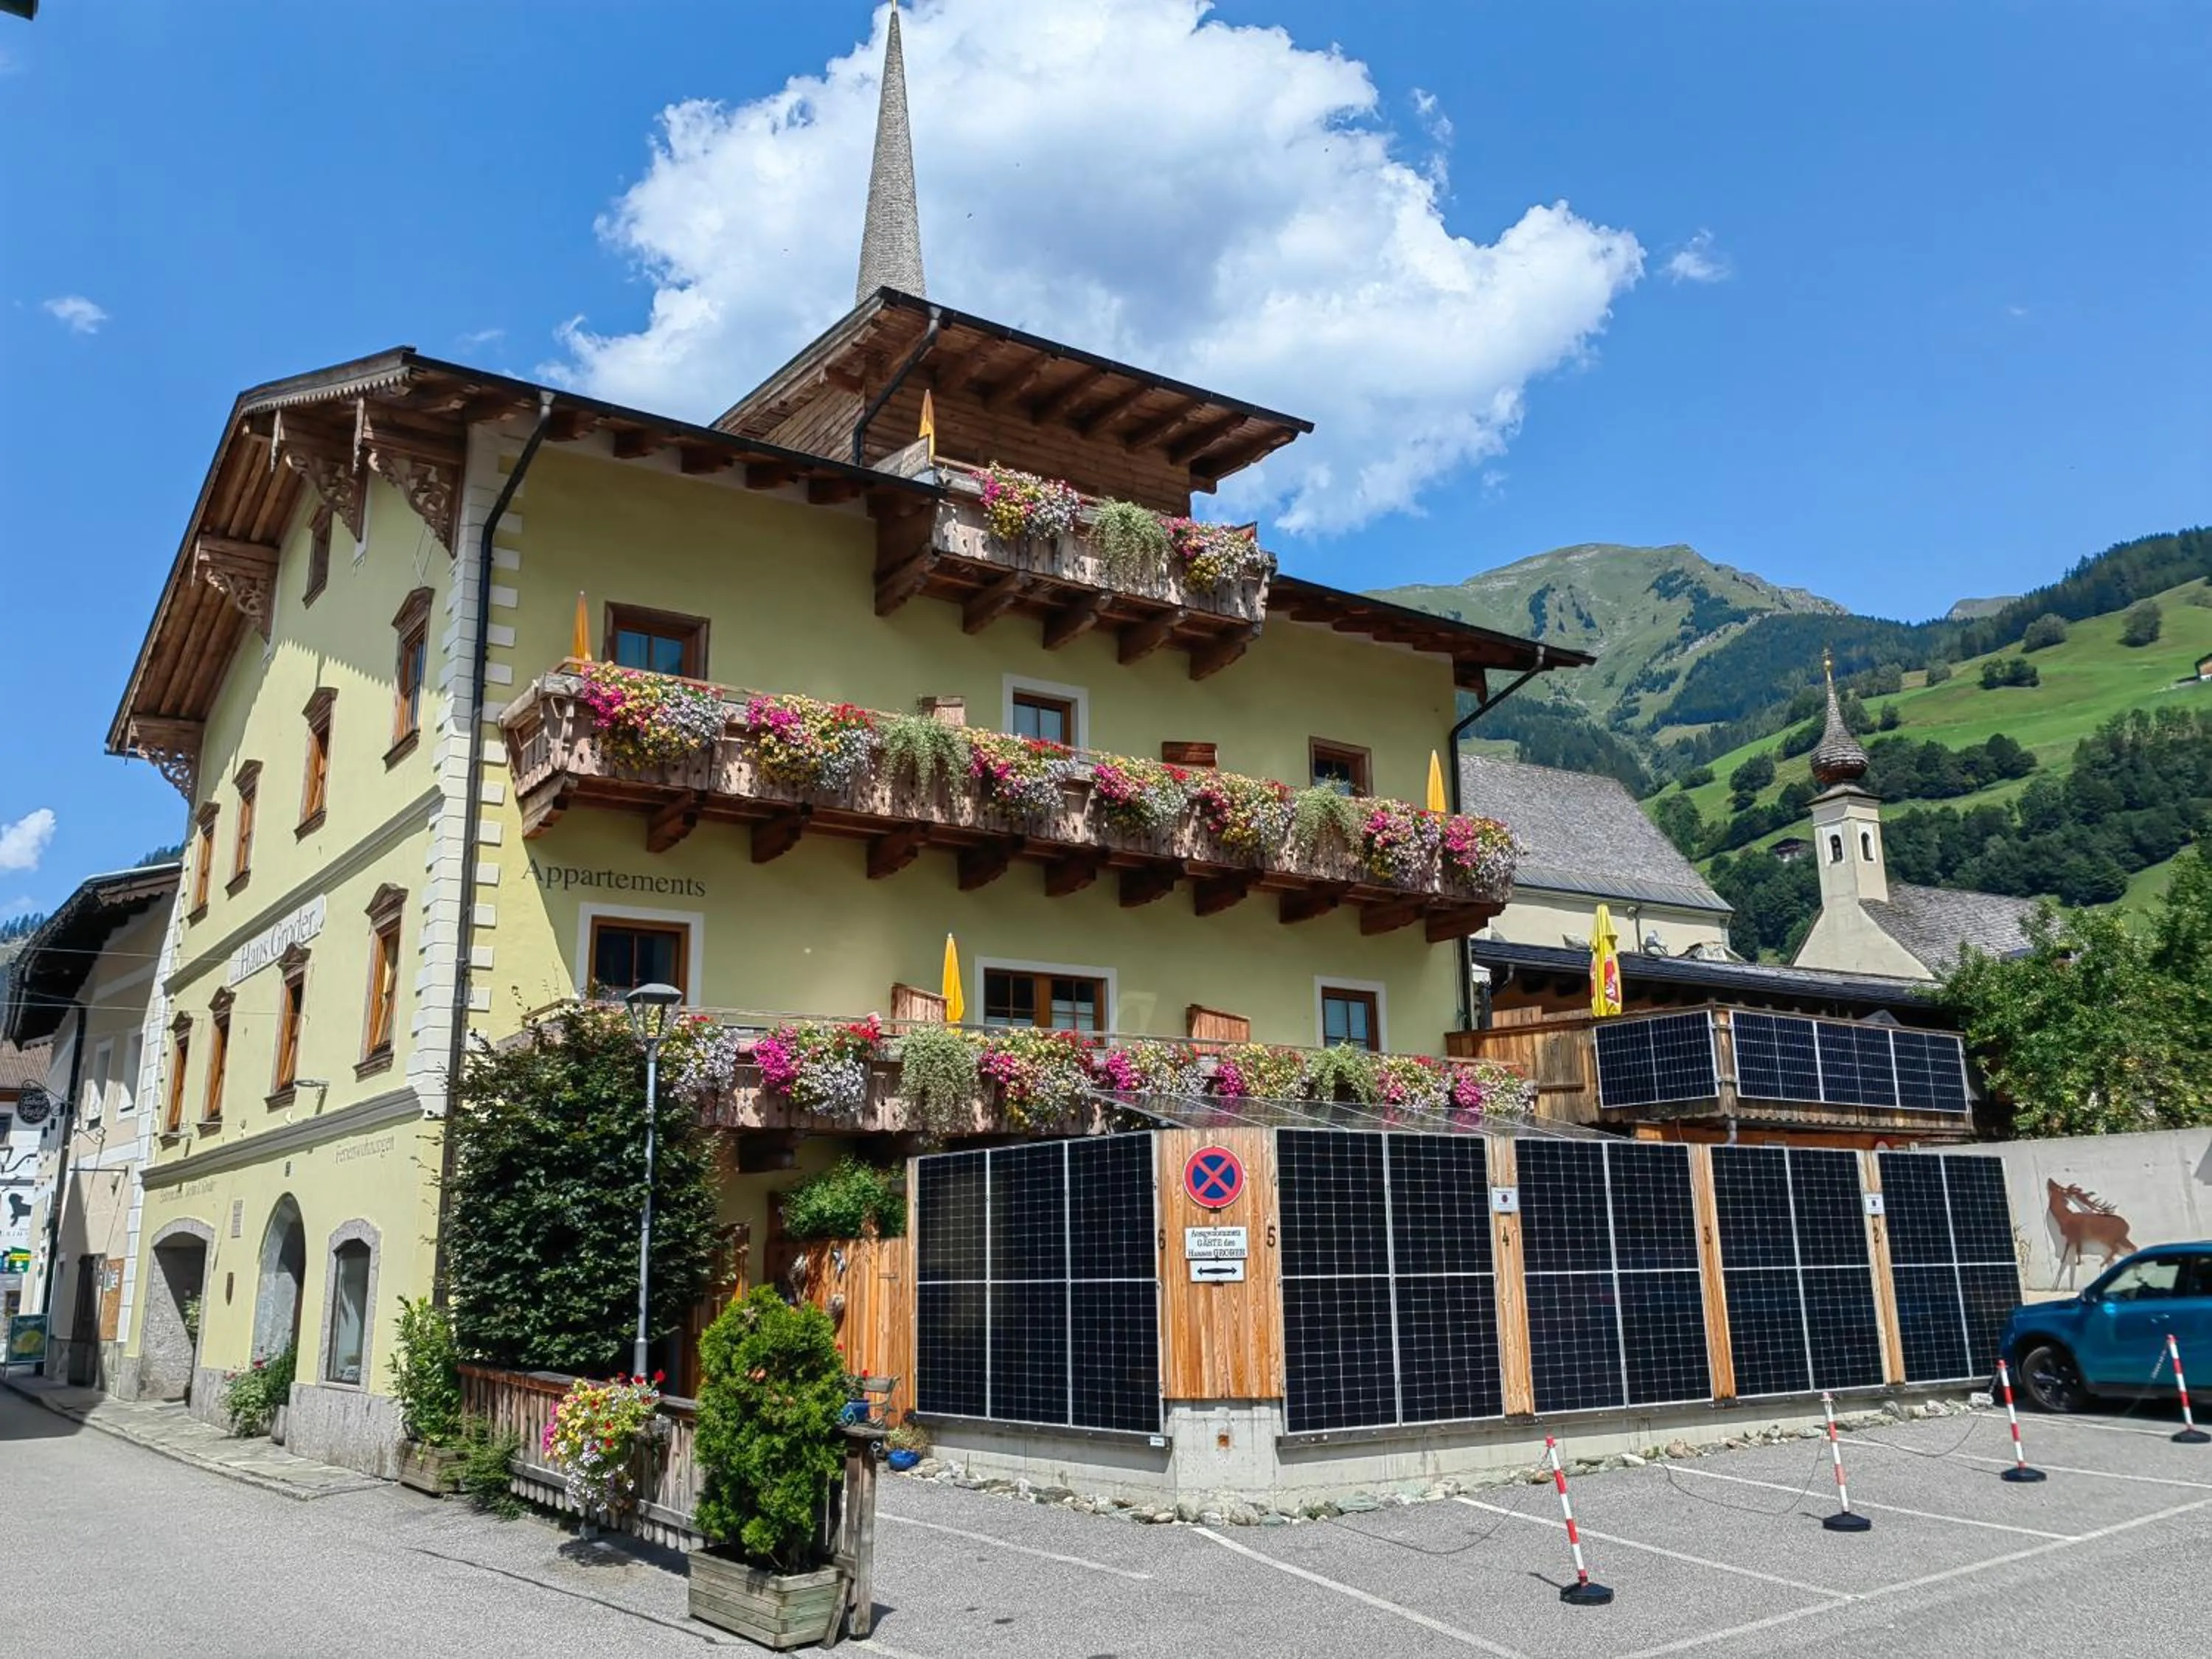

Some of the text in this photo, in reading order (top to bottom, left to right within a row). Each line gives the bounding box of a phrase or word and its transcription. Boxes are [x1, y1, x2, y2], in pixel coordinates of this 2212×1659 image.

[521, 858, 706, 897] Appartements
[240, 908, 316, 978] Haus Groder
[1158, 1228, 1166, 1251] 6
[1266, 1225, 1276, 1248] 5
[1502, 1226, 1509, 1247] 4
